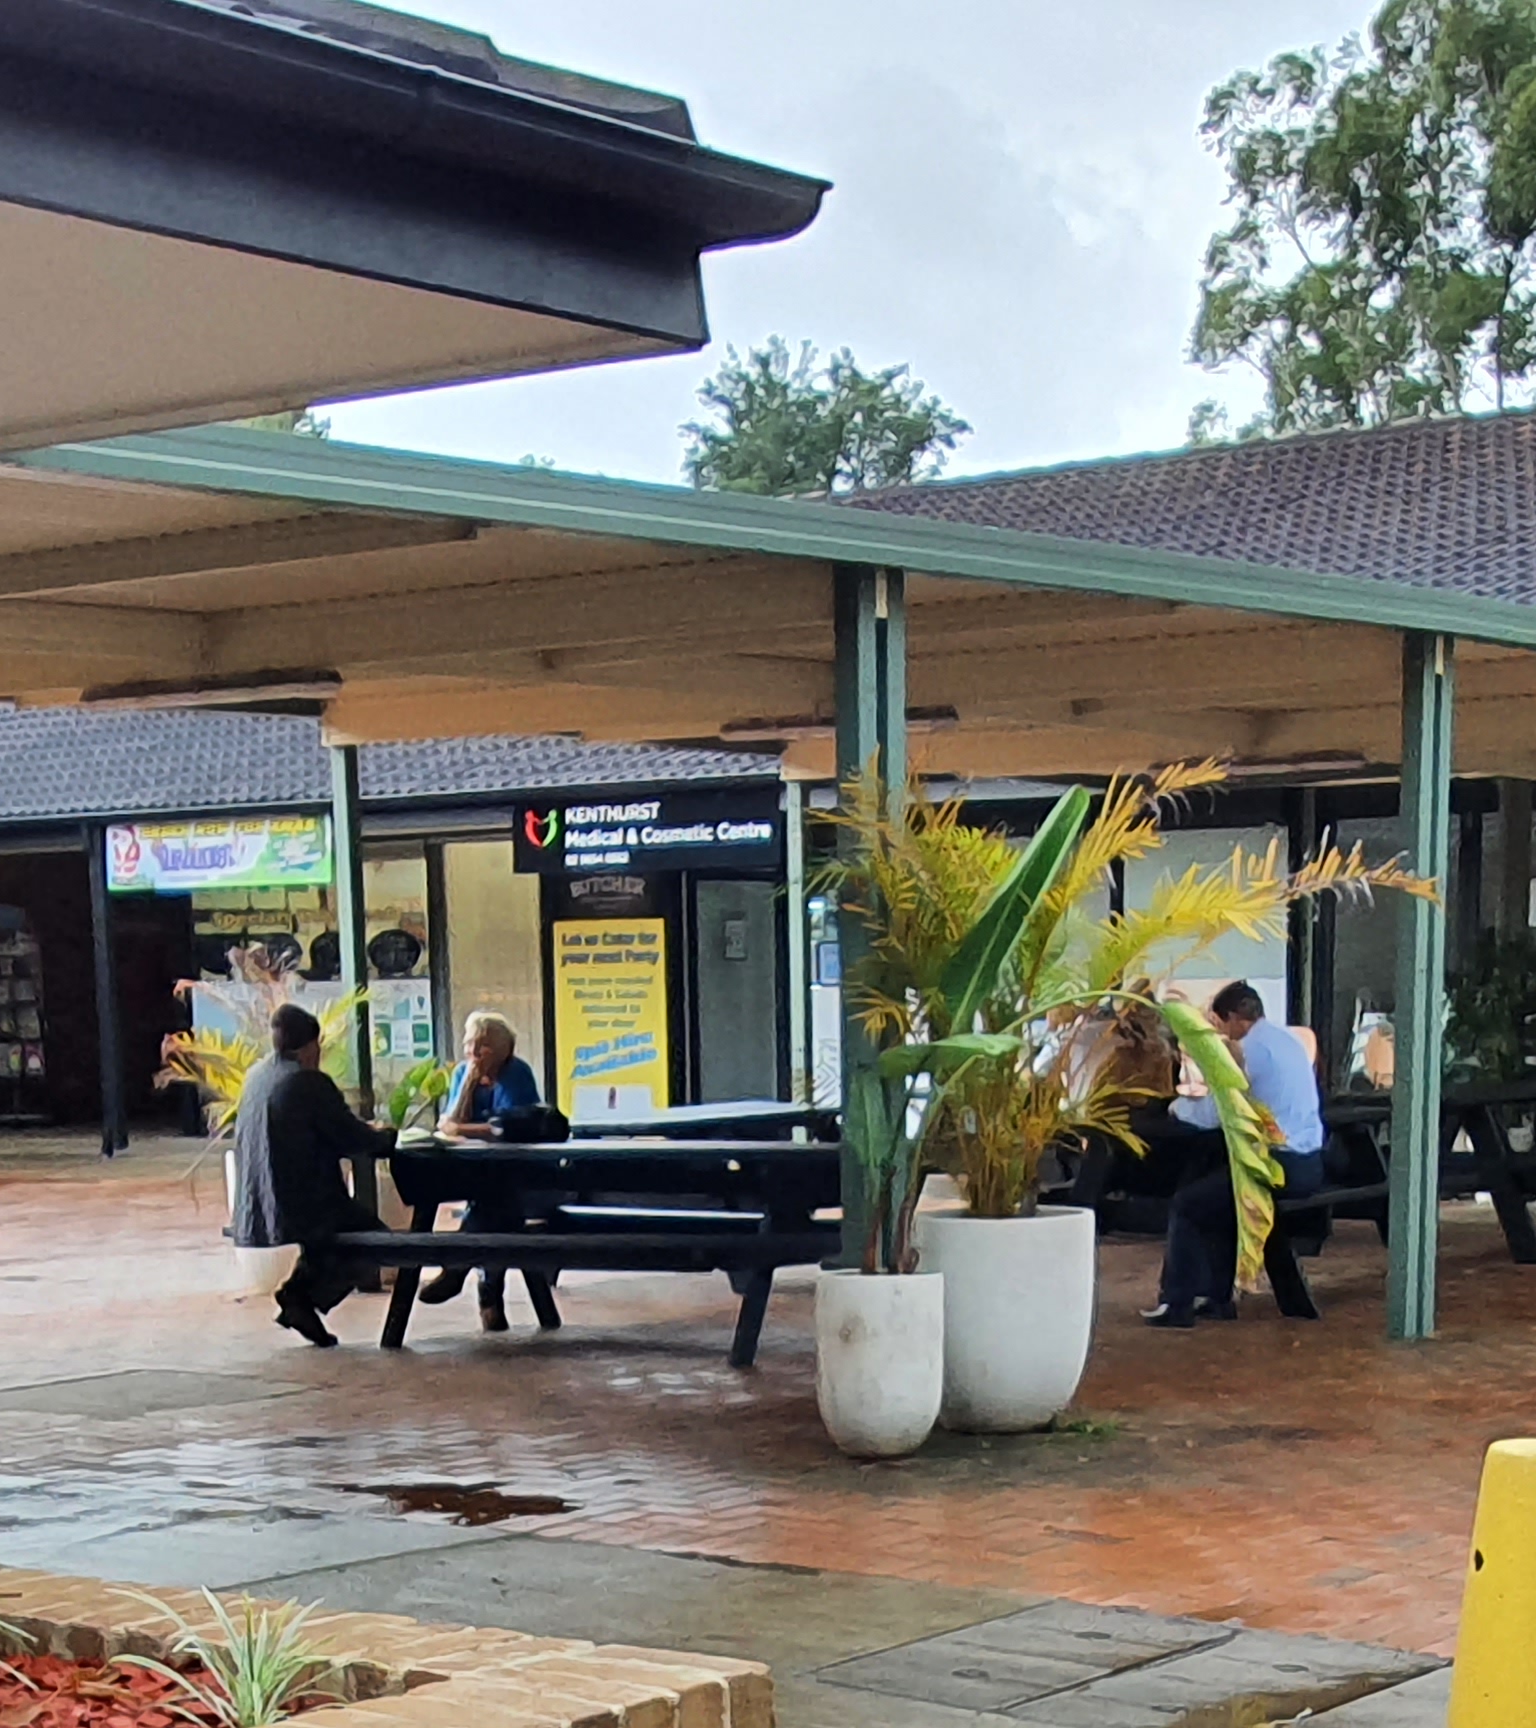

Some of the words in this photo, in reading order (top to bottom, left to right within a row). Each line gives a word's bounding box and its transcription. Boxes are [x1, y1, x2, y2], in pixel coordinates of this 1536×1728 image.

[565, 802, 661, 824] KENTHURST
[565, 828, 624, 848] Medical
[641, 824, 714, 844] Cosmetic
[716, 822, 773, 841] Centre
[570, 876, 647, 898] BUTCHER
